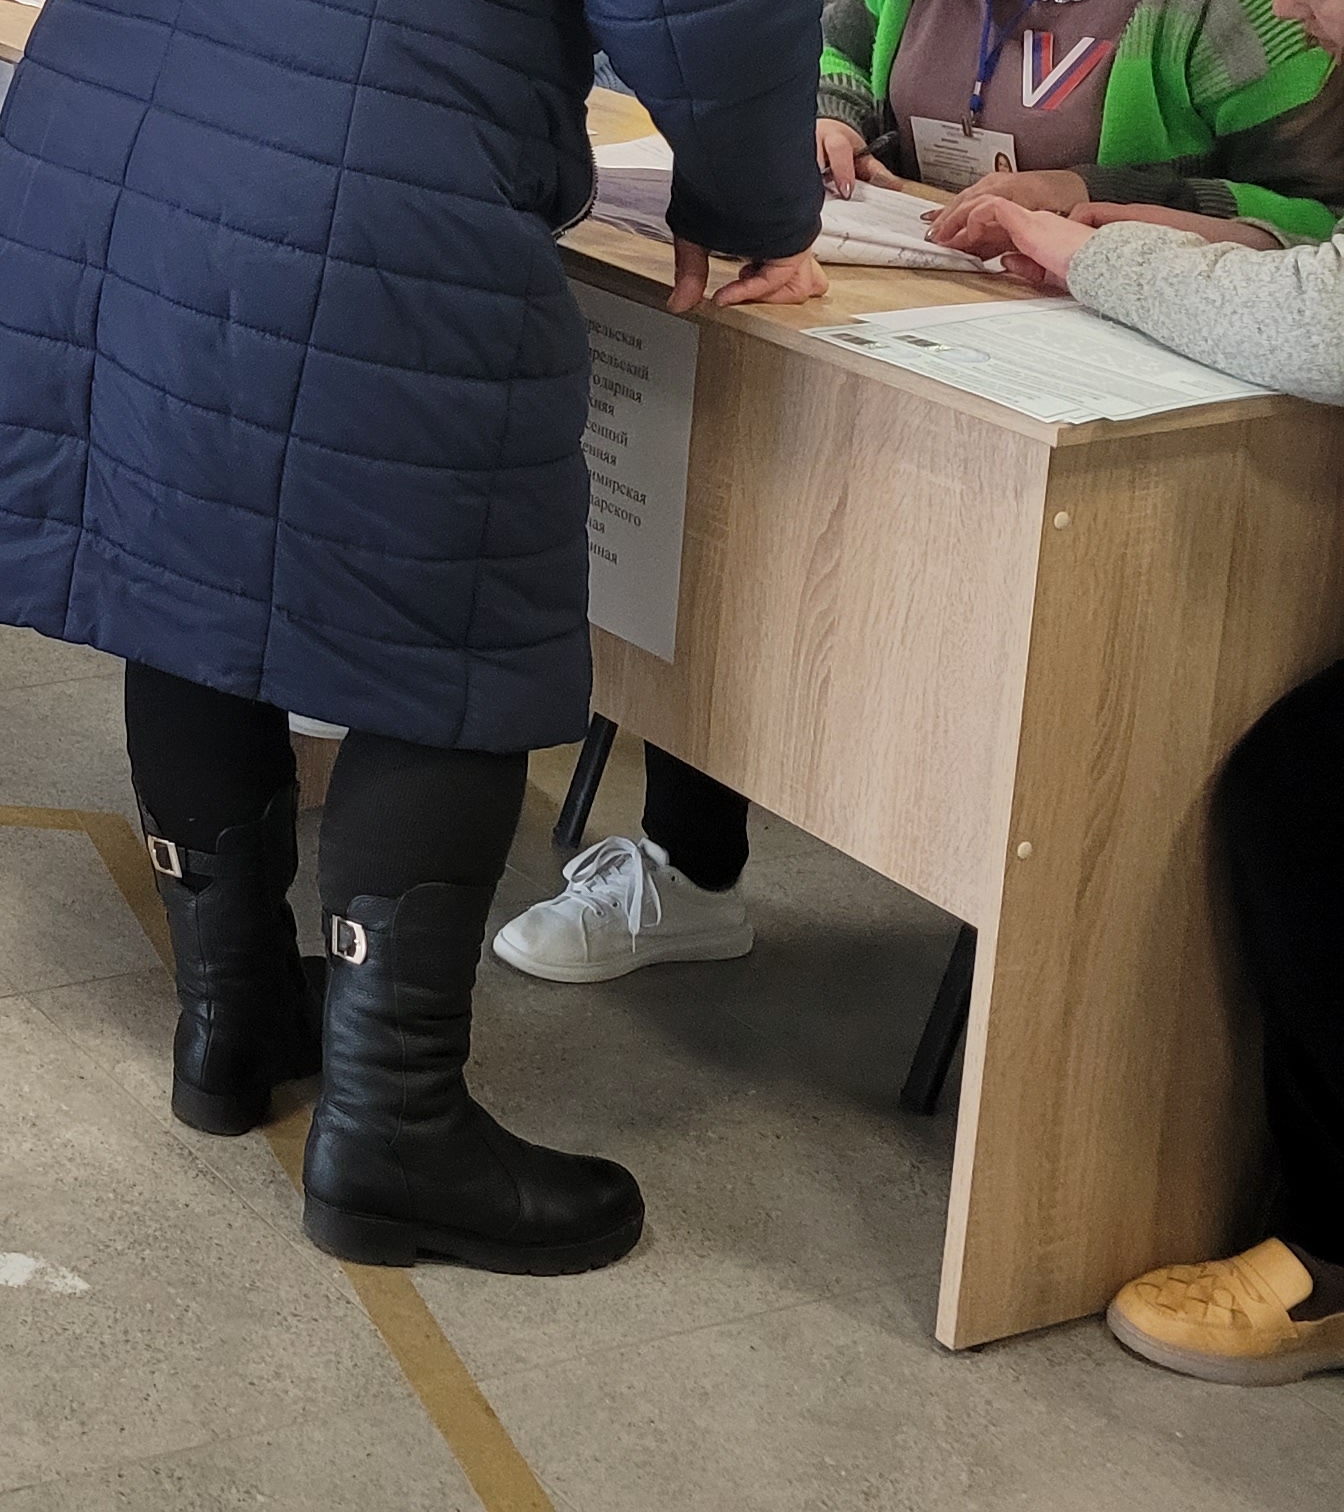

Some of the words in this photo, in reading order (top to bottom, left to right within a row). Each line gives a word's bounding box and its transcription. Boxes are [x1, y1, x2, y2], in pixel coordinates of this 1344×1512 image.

[587, 318, 643, 351] рельская
[589, 347, 650, 381] рельский
[592, 374, 643, 404] одарная
[585, 419, 629, 448] сенний
[582, 441, 617, 467] енняя
[587, 469, 648, 507] имирская
